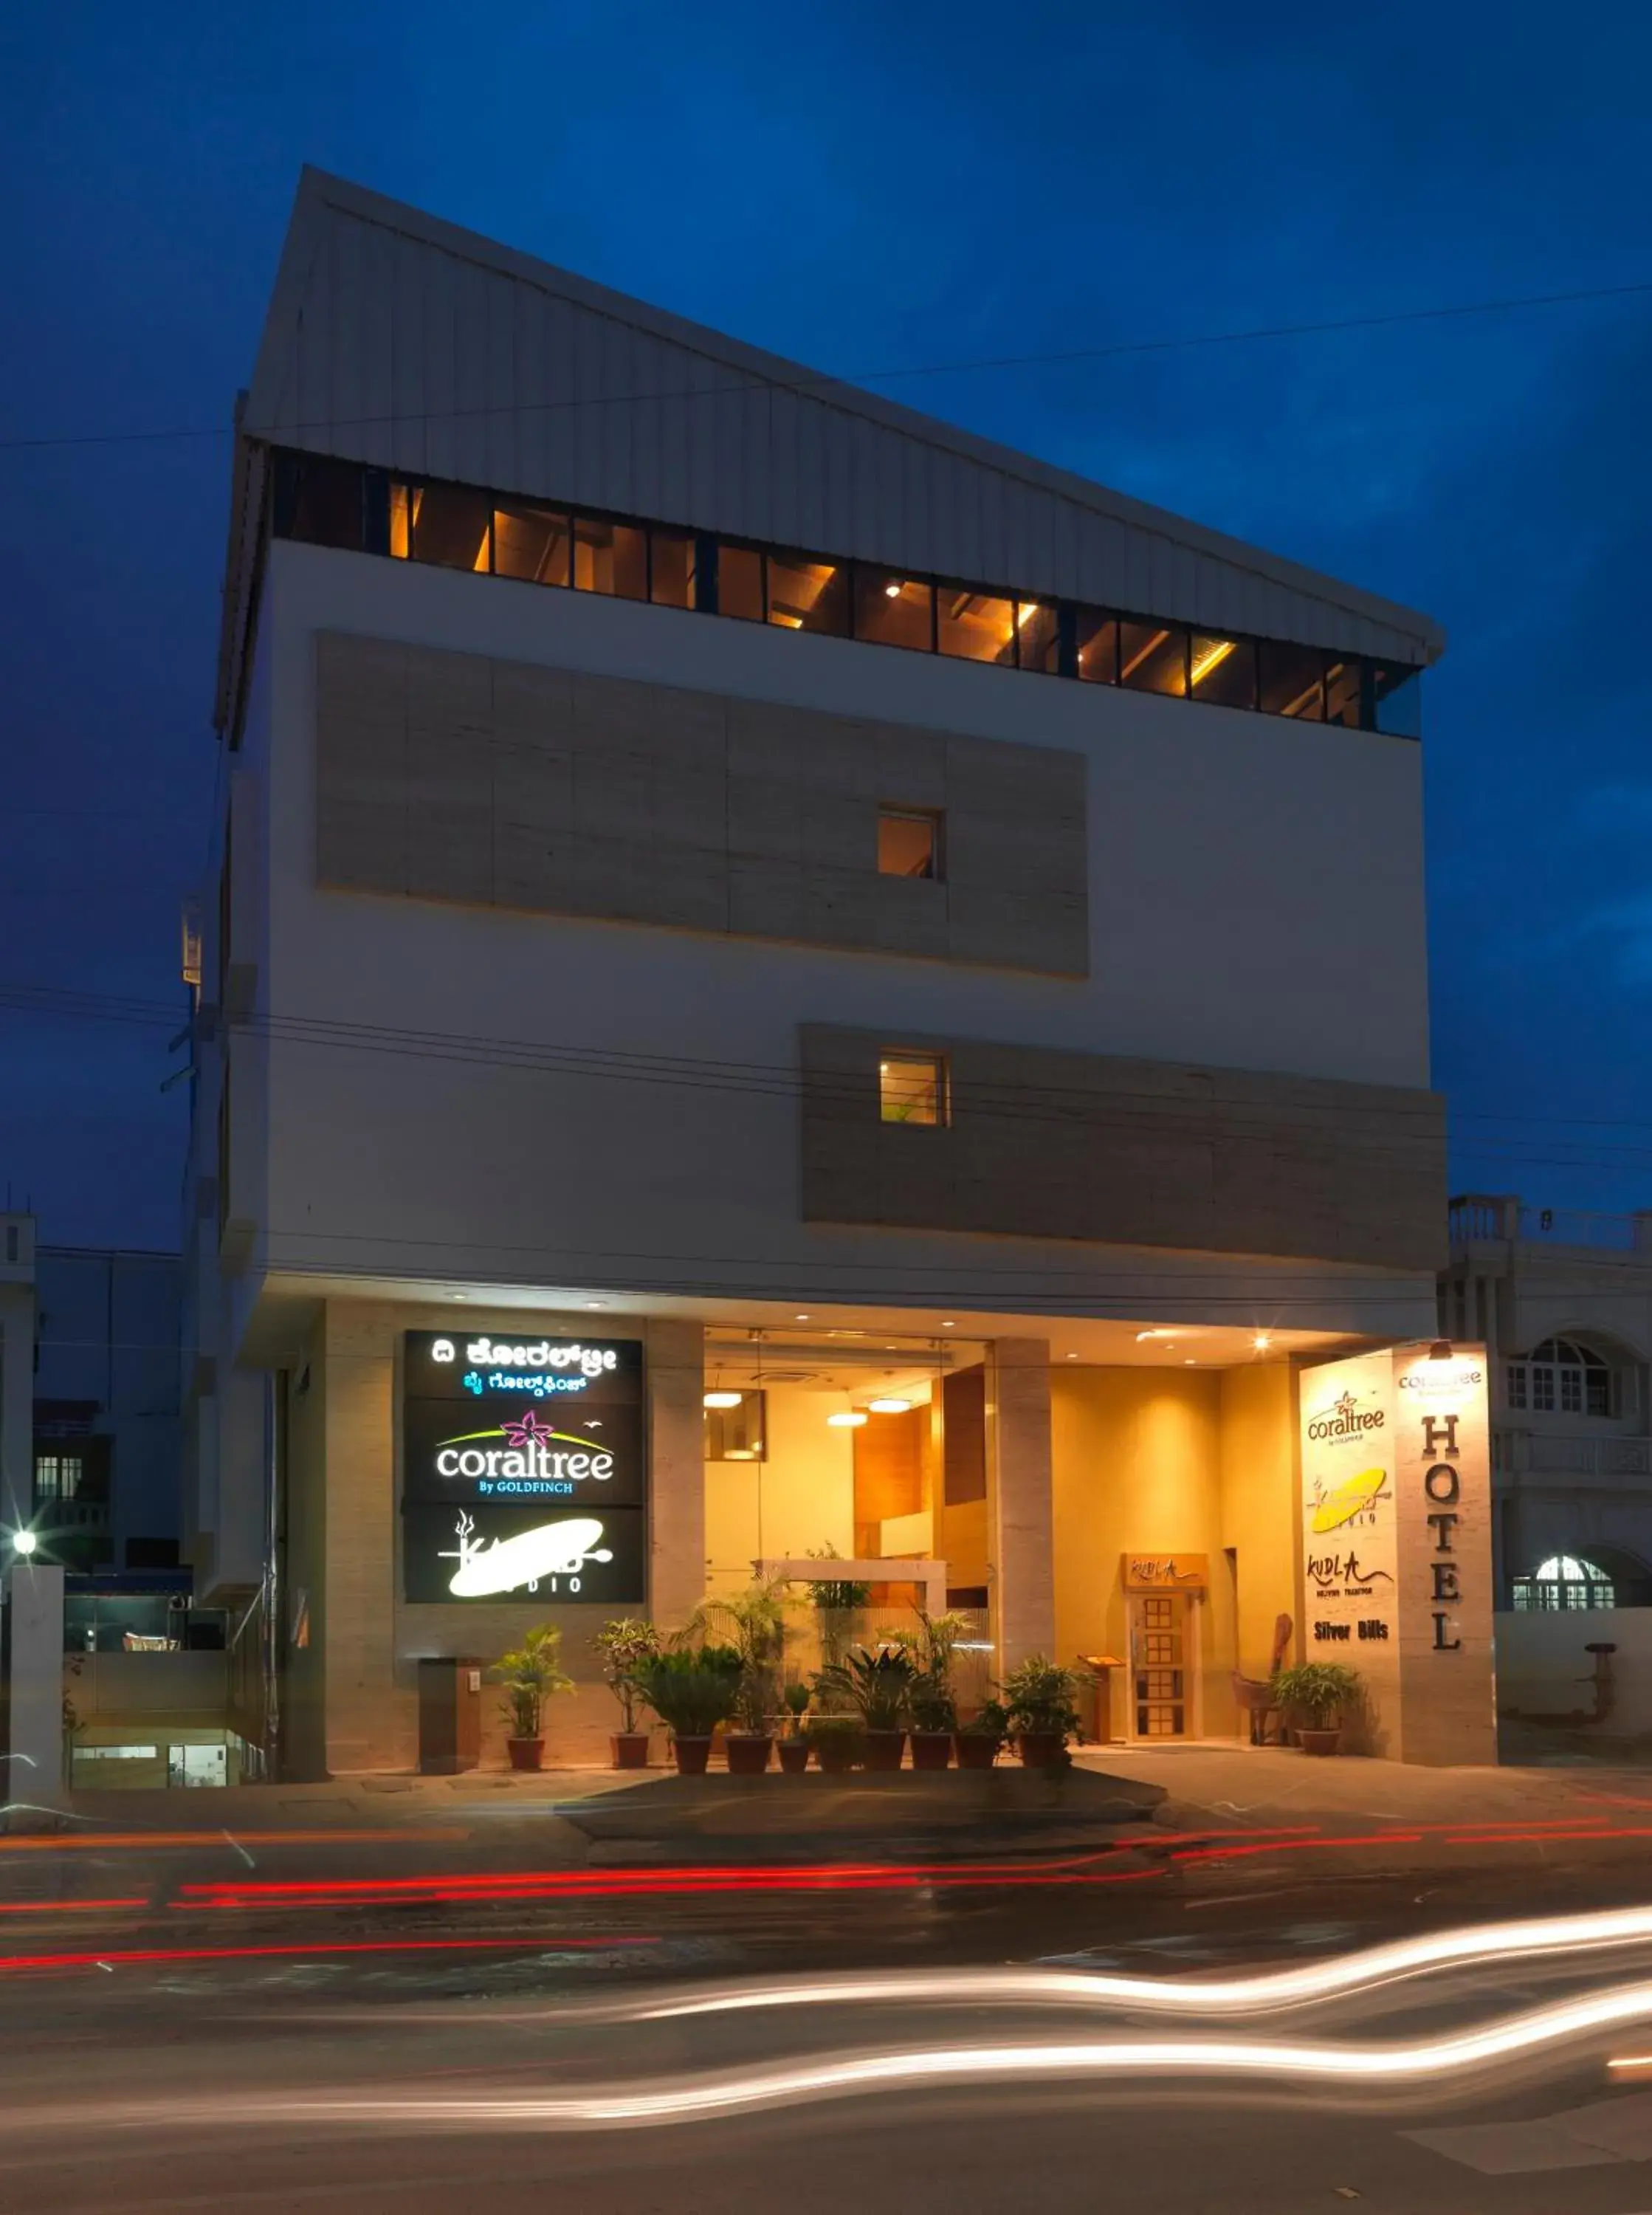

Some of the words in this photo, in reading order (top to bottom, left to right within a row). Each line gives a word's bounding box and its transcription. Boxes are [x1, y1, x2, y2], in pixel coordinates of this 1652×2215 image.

[1308, 1408, 1385, 1440] coraltree
[436, 1440, 614, 1480] coraltree
[479, 1481, 493, 1495] By
[497, 1481, 573, 1494] GOLDFINCH
[1422, 1415, 1461, 1650] HOTEL
